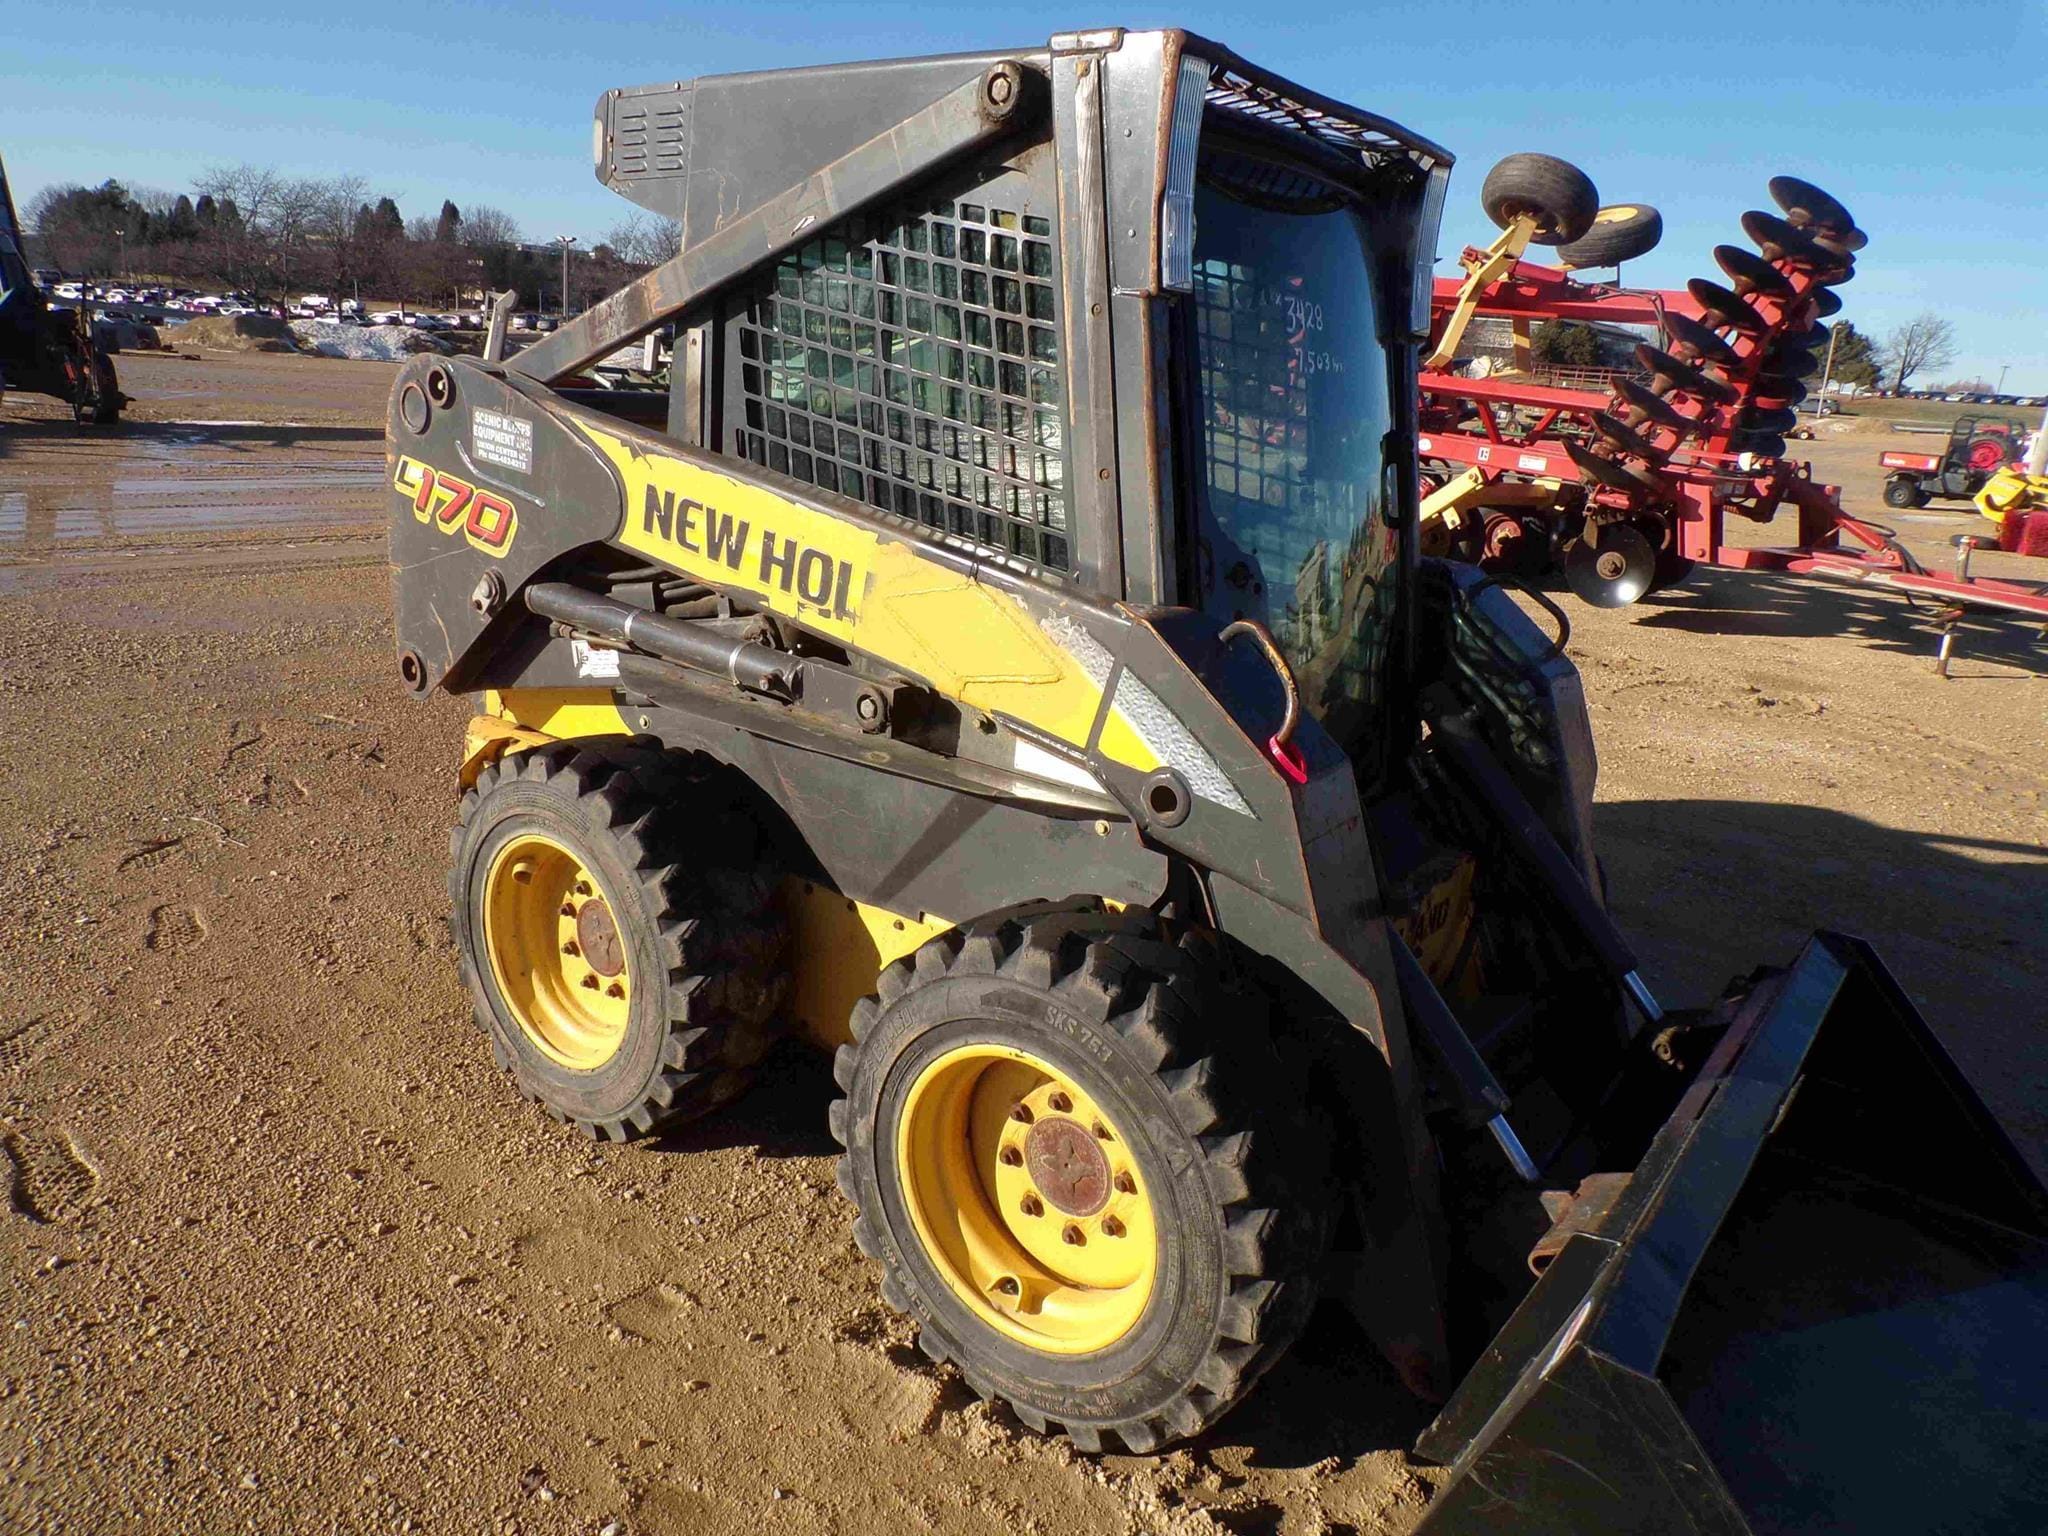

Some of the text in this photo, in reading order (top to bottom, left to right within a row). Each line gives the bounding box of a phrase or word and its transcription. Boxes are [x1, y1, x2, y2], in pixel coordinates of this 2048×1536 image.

[1284, 296, 1324, 333] 3428
[473, 424, 515, 448] EQUIPMENT
[474, 410, 502, 429] SCENIC
[395, 457, 517, 556] L170
[643, 482, 751, 572] NEW
[1045, 1005, 1078, 1036] SKS
